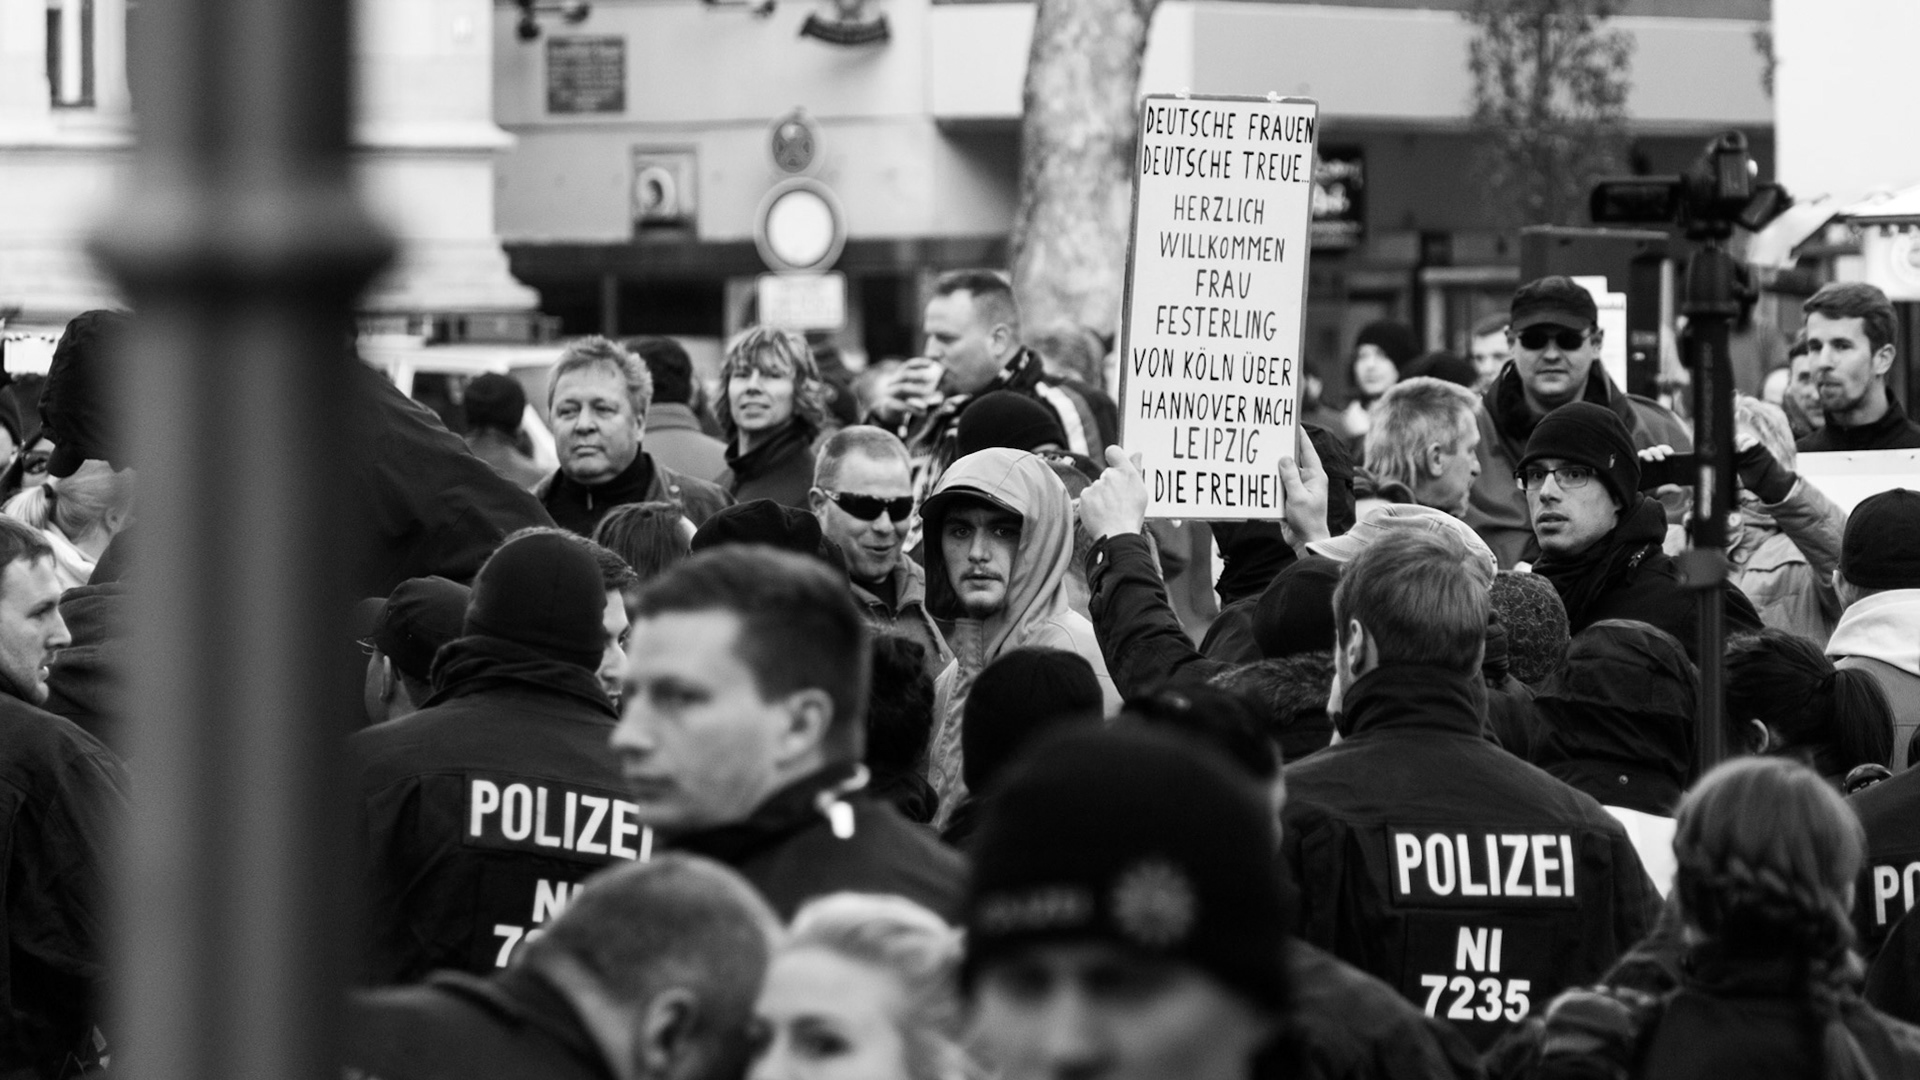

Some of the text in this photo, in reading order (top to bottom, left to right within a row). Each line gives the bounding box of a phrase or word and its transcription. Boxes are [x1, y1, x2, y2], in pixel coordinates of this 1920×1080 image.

[1146, 106, 1315, 144] DEUTSCHE FRAUEN
[1143, 144, 1232, 178] DEUTSCHE
[1174, 194, 1265, 225] HERZLICH
[1160, 231, 1285, 263] WILLKOMMEN
[1195, 269, 1251, 299] FRAU
[1156, 305, 1277, 341] FESTERLING
[1134, 347, 1292, 386] VON KÖLN ÜBER
[1141, 390, 1293, 426] HANNOVER NACH
[1173, 426, 1260, 464] LEIPZIG
[1155, 469, 1187, 503] DIE
[1196, 470, 1277, 508] FREIHEI
[470, 779, 653, 863] POLIZEI
[1395, 833, 1574, 897] POLIZEI
[1456, 926, 1503, 973] NI
[1421, 974, 1531, 1022] 7235
